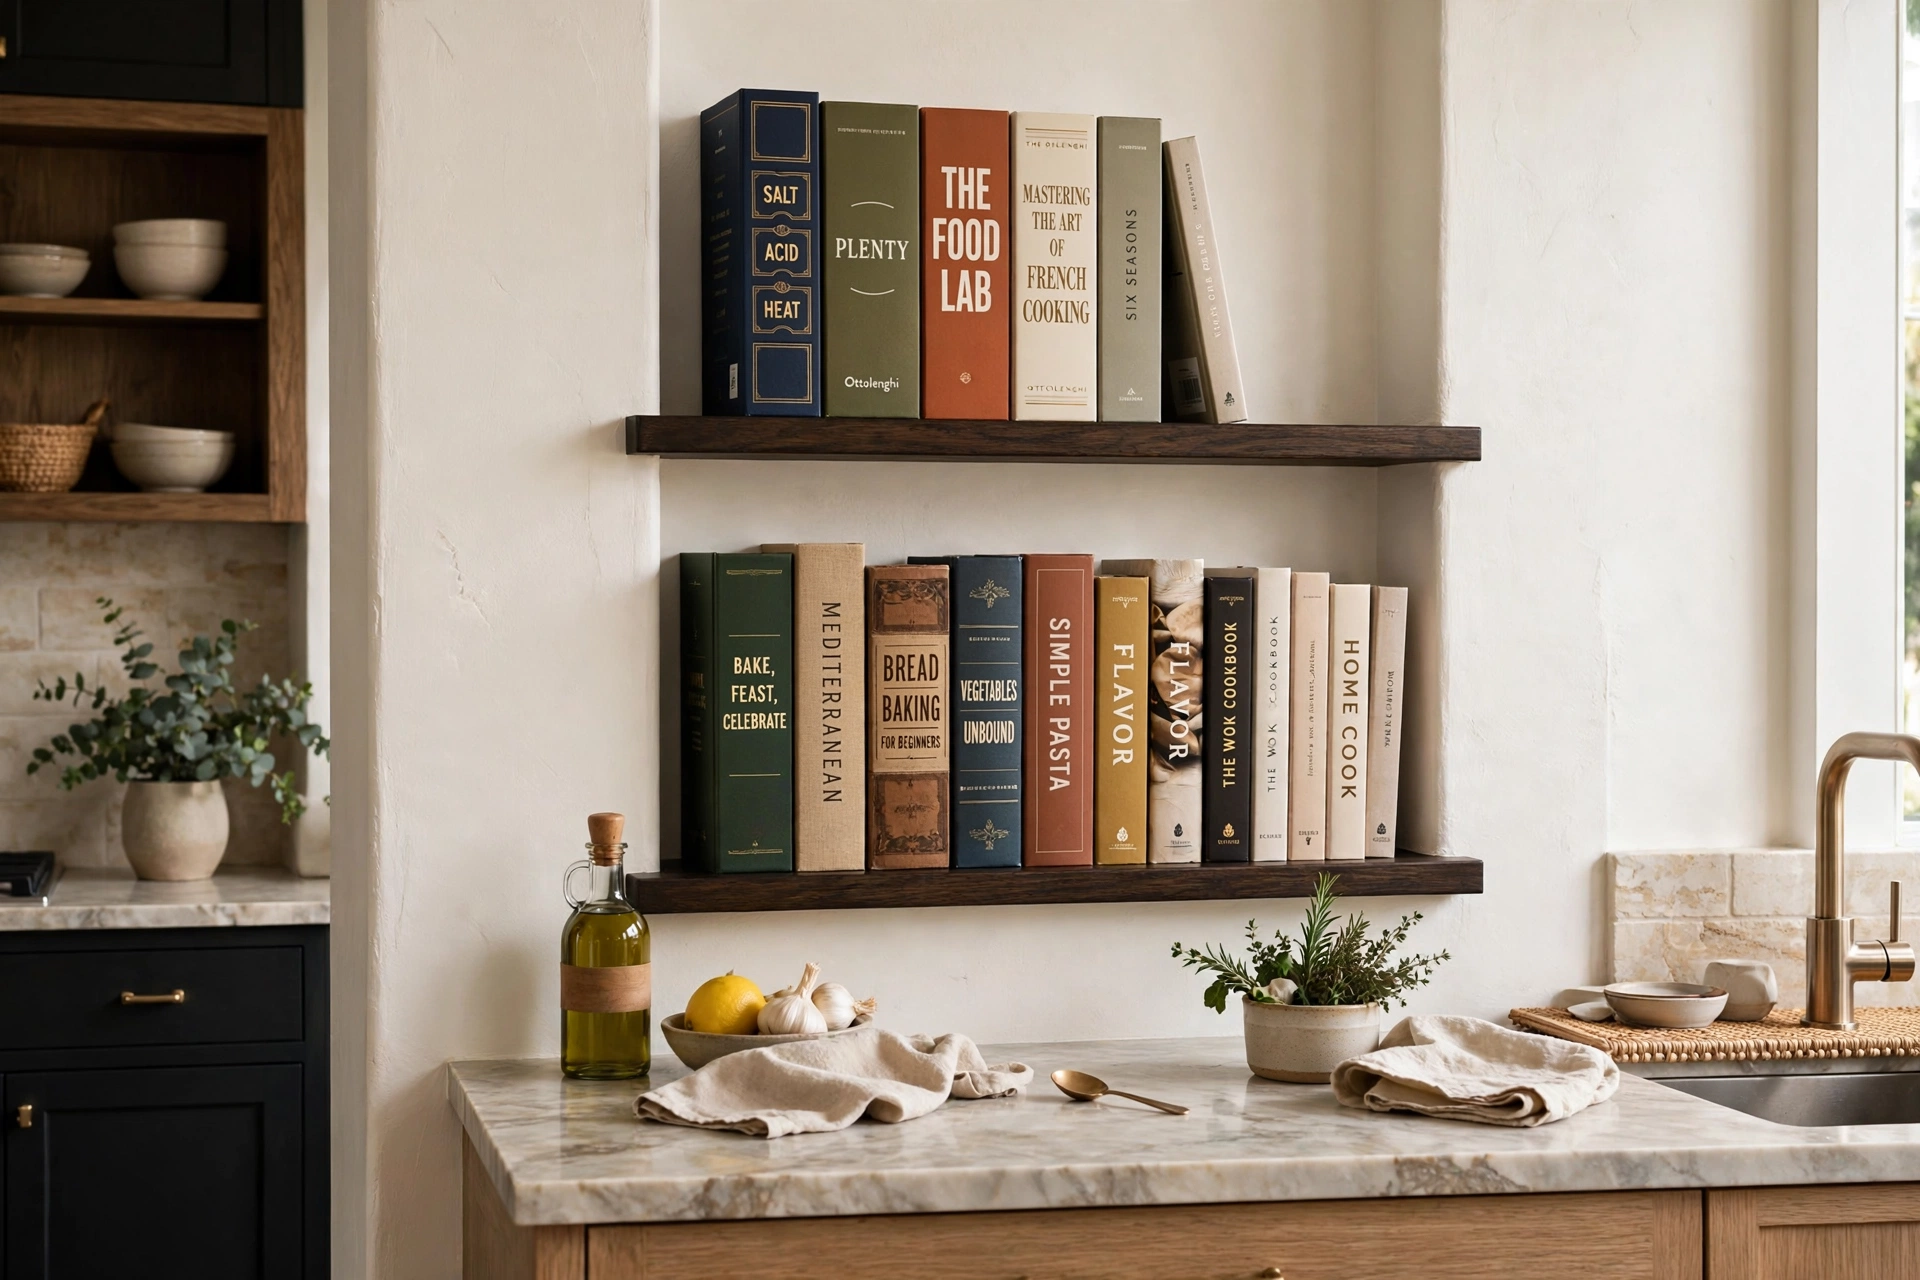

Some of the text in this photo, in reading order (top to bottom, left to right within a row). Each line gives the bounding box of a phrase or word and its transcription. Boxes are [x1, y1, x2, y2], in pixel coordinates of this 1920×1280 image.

[764, 185, 798, 204] SALT
[941, 166, 990, 210] THE
[1023, 184, 1090, 206] MASTERING
[1032, 212, 1082, 231] THE ART
[836, 238, 909, 260] PLENTY
[933, 218, 1000, 261] FOOD
[1050, 239, 1064, 256] OF
[765, 243, 798, 261] ACID
[1126, 210, 1137, 320] SIX SEASONS
[1028, 266, 1086, 290] FRENCH
[942, 269, 991, 312] LAB
[765, 301, 800, 318] HEAT
[1023, 299, 1089, 324] COOKING
[845, 377, 899, 392] Ottolenghi
[734, 657, 774, 677] BAKE,
[884, 654, 938, 682] BREAD
[732, 685, 777, 704] FEAST,
[822, 603, 842, 801] MEDITERRANEAN
[961, 680, 1017, 701] VEGETABLES
[1169, 641, 1190, 760] FLAVOR
[883, 695, 940, 722] BAKING
[1050, 618, 1070, 791] SIMPLE PASTA
[1113, 644, 1134, 765] FLAVOR
[1223, 623, 1237, 787] THE WOK COOKBOOK
[723, 713, 786, 729] CELEBRATE
[1341, 640, 1359, 798] HOME COOK
[881, 736, 940, 749] FOR BEGINNERS
[964, 721, 1014, 743] UNBOUND
[1267, 724, 1277, 757] WOK
[1267, 767, 1277, 793] THE
